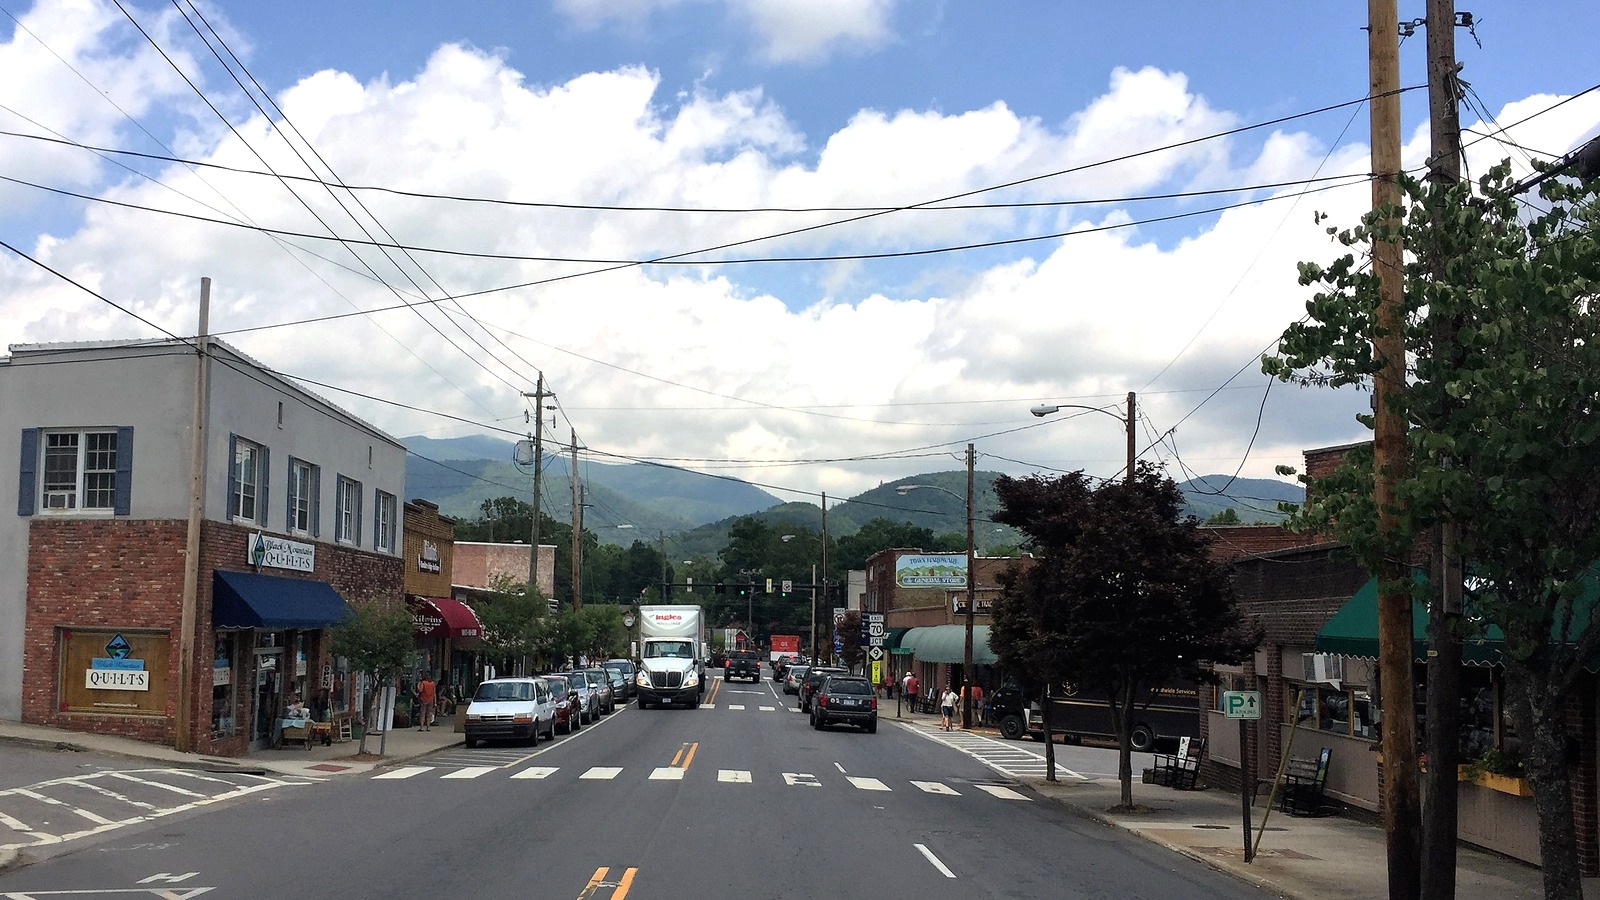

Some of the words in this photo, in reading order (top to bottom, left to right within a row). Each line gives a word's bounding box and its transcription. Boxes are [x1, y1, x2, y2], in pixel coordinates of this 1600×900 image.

[264, 539, 283, 552] Black
[870, 625, 882, 634] 70
[873, 649, 880, 658] 9
